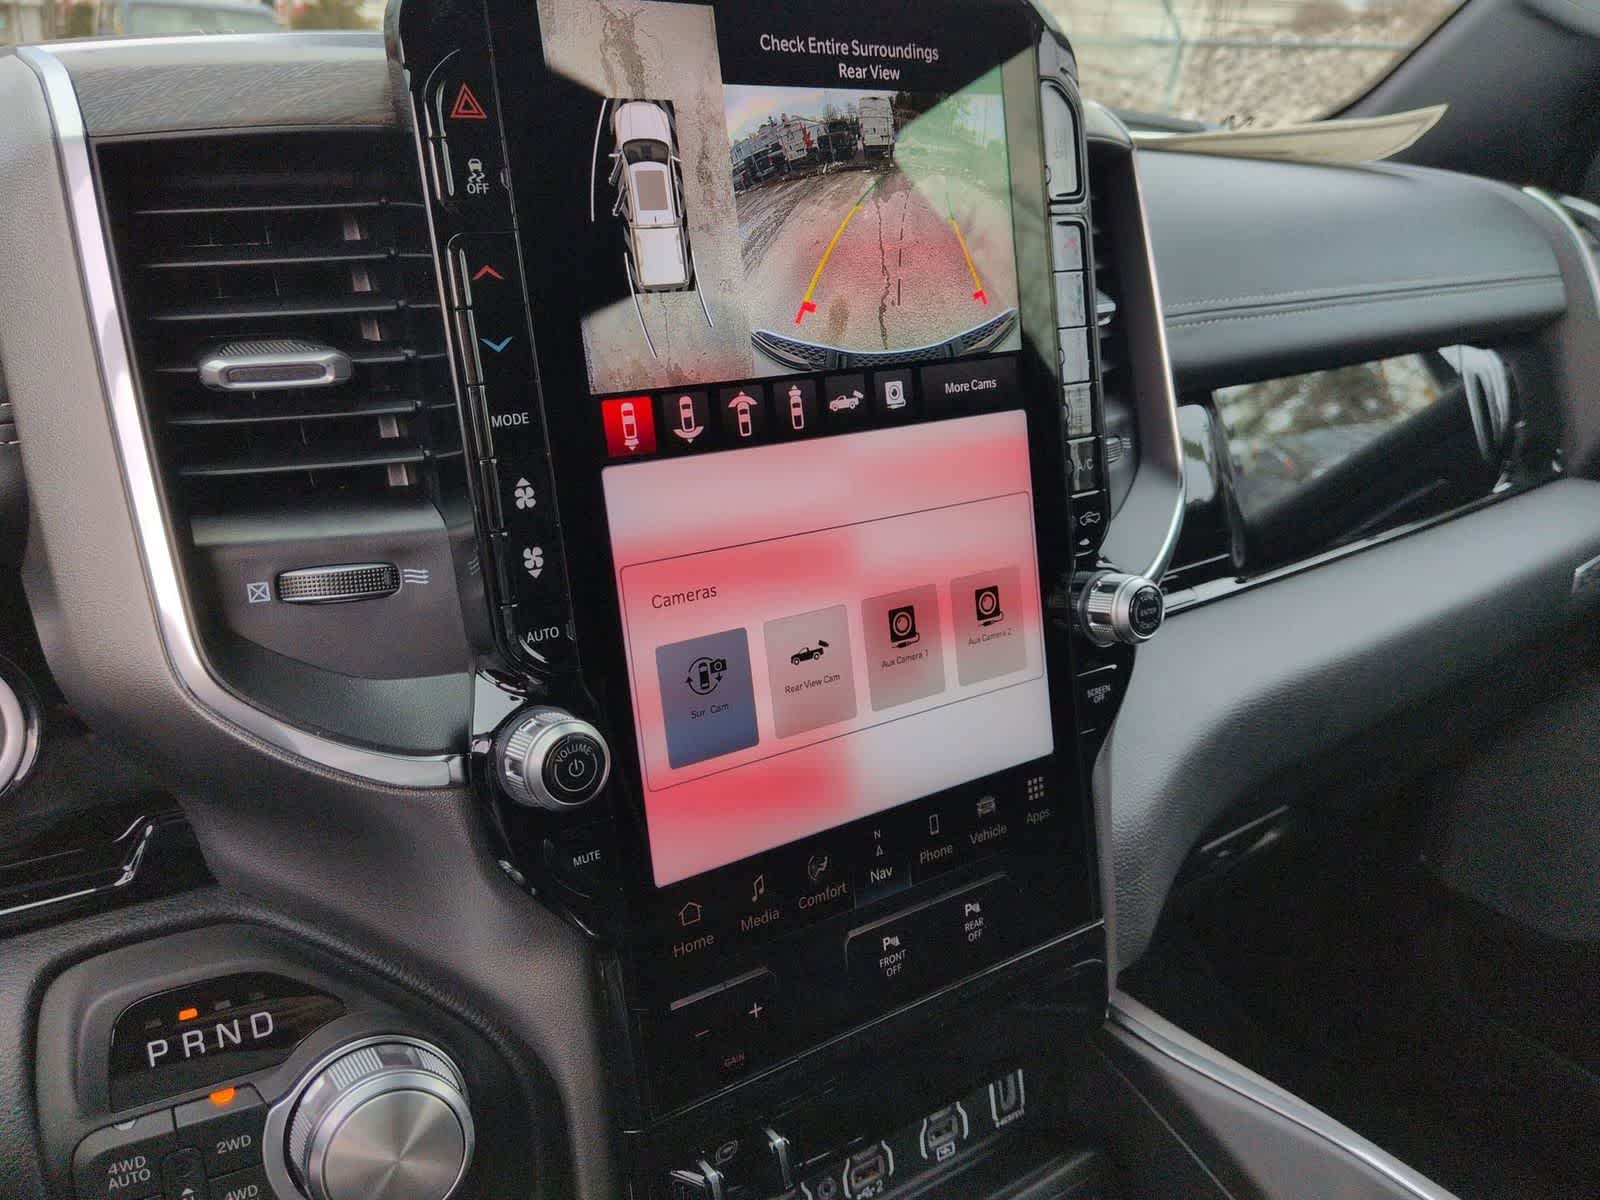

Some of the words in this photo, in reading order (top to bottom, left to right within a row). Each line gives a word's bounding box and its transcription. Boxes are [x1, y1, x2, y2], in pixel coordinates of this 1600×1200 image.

[760, 34, 806, 53] Check
[808, 36, 849, 55] Entire
[851, 39, 940, 63] Surroundings
[838, 63, 868, 79] Rear
[870, 65, 901, 80] View
[466, 183, 490, 195] OFF
[944, 382, 970, 395] More
[971, 379, 997, 391] Cams
[490, 412, 530, 428] MODE
[651, 585, 718, 609] Cameras
[527, 626, 560, 643] AUTO
[881, 658, 895, 669] Aux
[896, 651, 923, 665] Camera
[784, 682, 803, 695] Rear
[803, 678, 823, 690] View
[823, 672, 841, 684] Cam
[710, 702, 729, 714] Cam
[555, 743, 593, 763] VOLUME
[1026, 808, 1051, 825] Apps
[969, 823, 1008, 845] Vehicle
[572, 849, 601, 867] MUTE
[919, 843, 953, 864] Phone
[870, 866, 893, 883] Nav
[798, 881, 848, 910] Comfort
[740, 908, 780, 931] Media
[964, 917, 984, 932] REAR
[968, 929, 983, 942] OFF
[671, 934, 715, 958] Home
[879, 949, 907, 968] FRONT
[886, 963, 902, 977] OFF
[216, 1135, 252, 1155] 2WD
[108, 1155, 147, 1176] 4WD
[108, 1168, 151, 1191] AUTO
